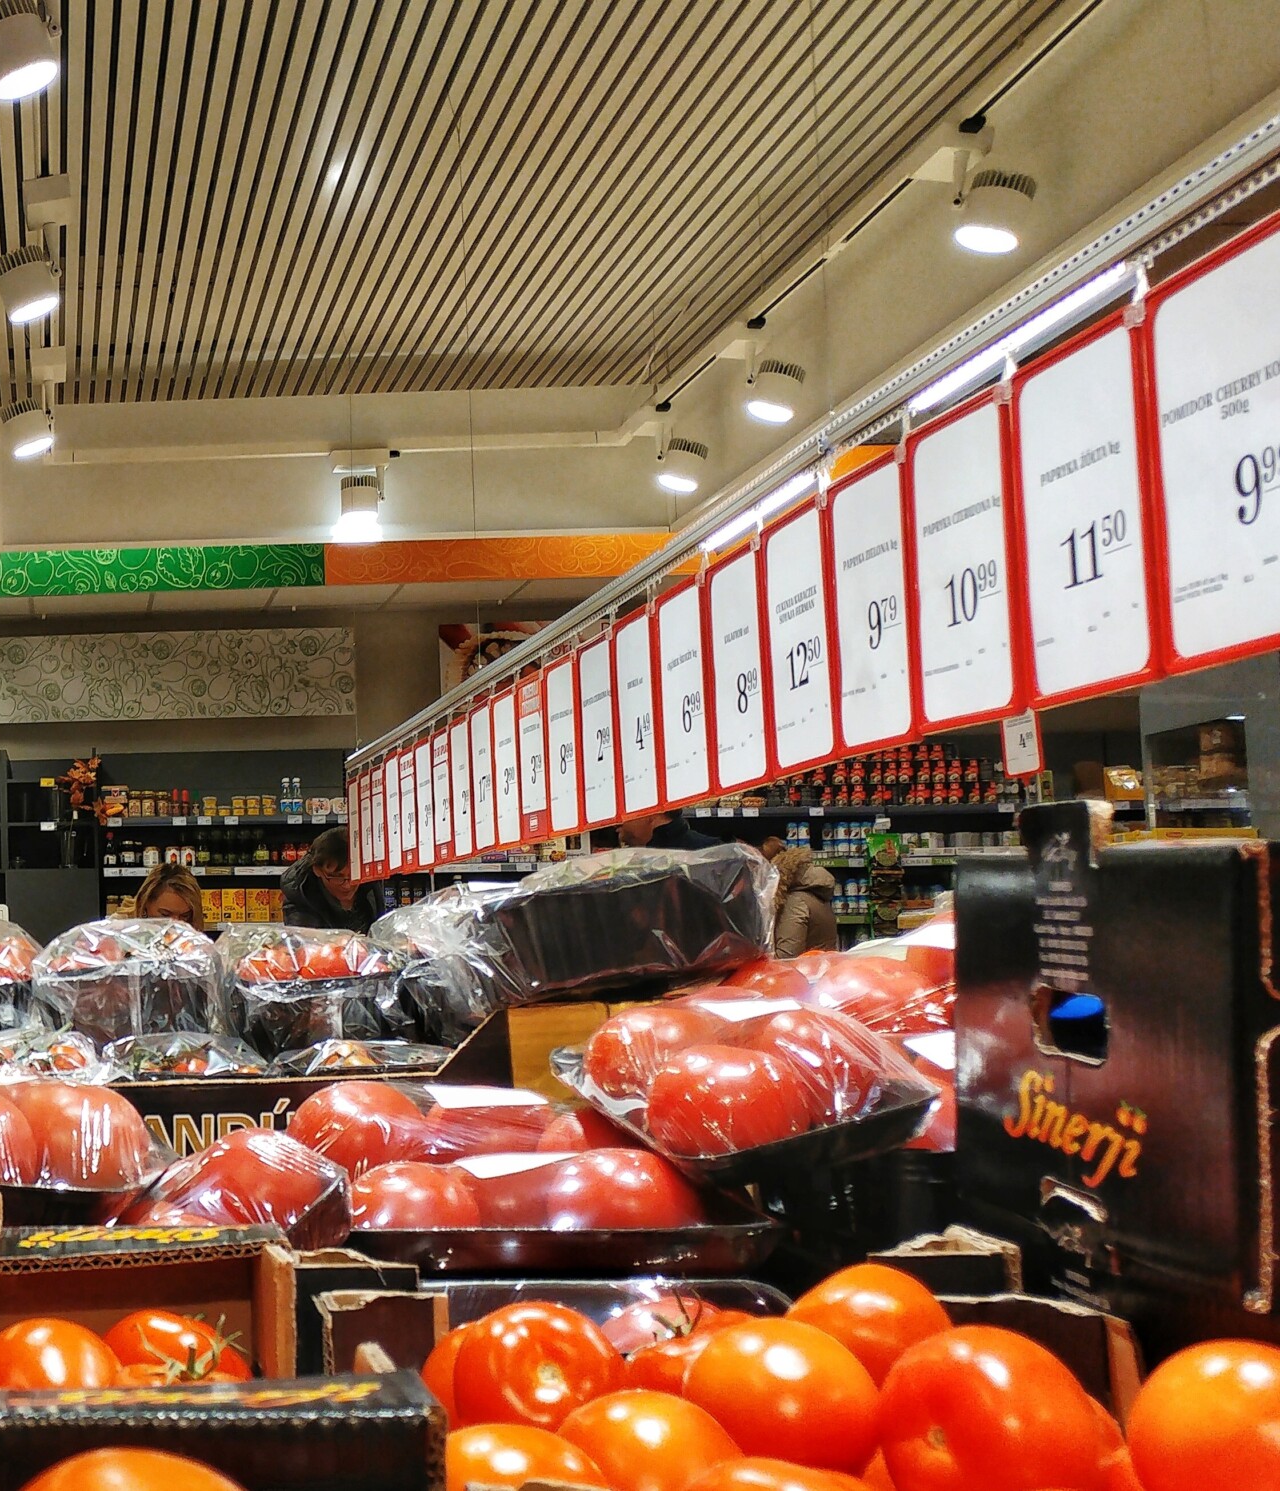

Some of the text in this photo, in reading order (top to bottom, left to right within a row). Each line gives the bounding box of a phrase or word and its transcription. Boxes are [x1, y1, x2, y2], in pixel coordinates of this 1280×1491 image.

[1161, 359, 1280, 428] POMIDOR CHERRY KO
[1220, 399, 1250, 420] 500g
[1040, 459, 1079, 487] PAPRYKA
[1108, 441, 1121, 455] kg
[923, 515, 951, 537] PAPRYKA
[1003, 1069, 1148, 1189] Sinerji
